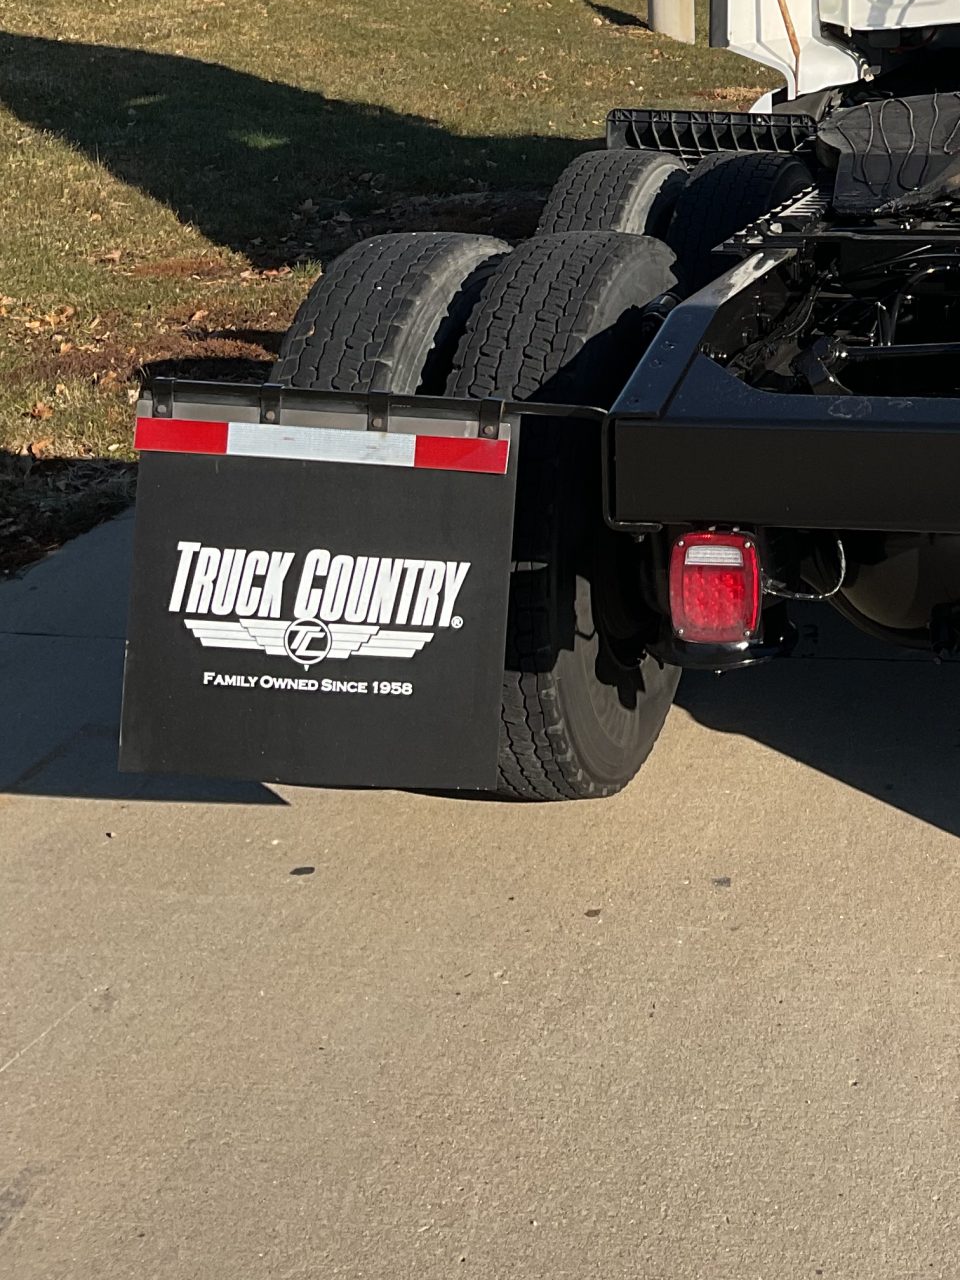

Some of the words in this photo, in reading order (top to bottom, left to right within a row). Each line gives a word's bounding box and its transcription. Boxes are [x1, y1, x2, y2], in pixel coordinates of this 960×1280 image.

[168, 541, 296, 619] TRUCK
[203, 672, 258, 688] FAMILY
[260, 675, 319, 691] OWNED
[321, 678, 368, 694] SINCE
[372, 681, 413, 695] 1958
